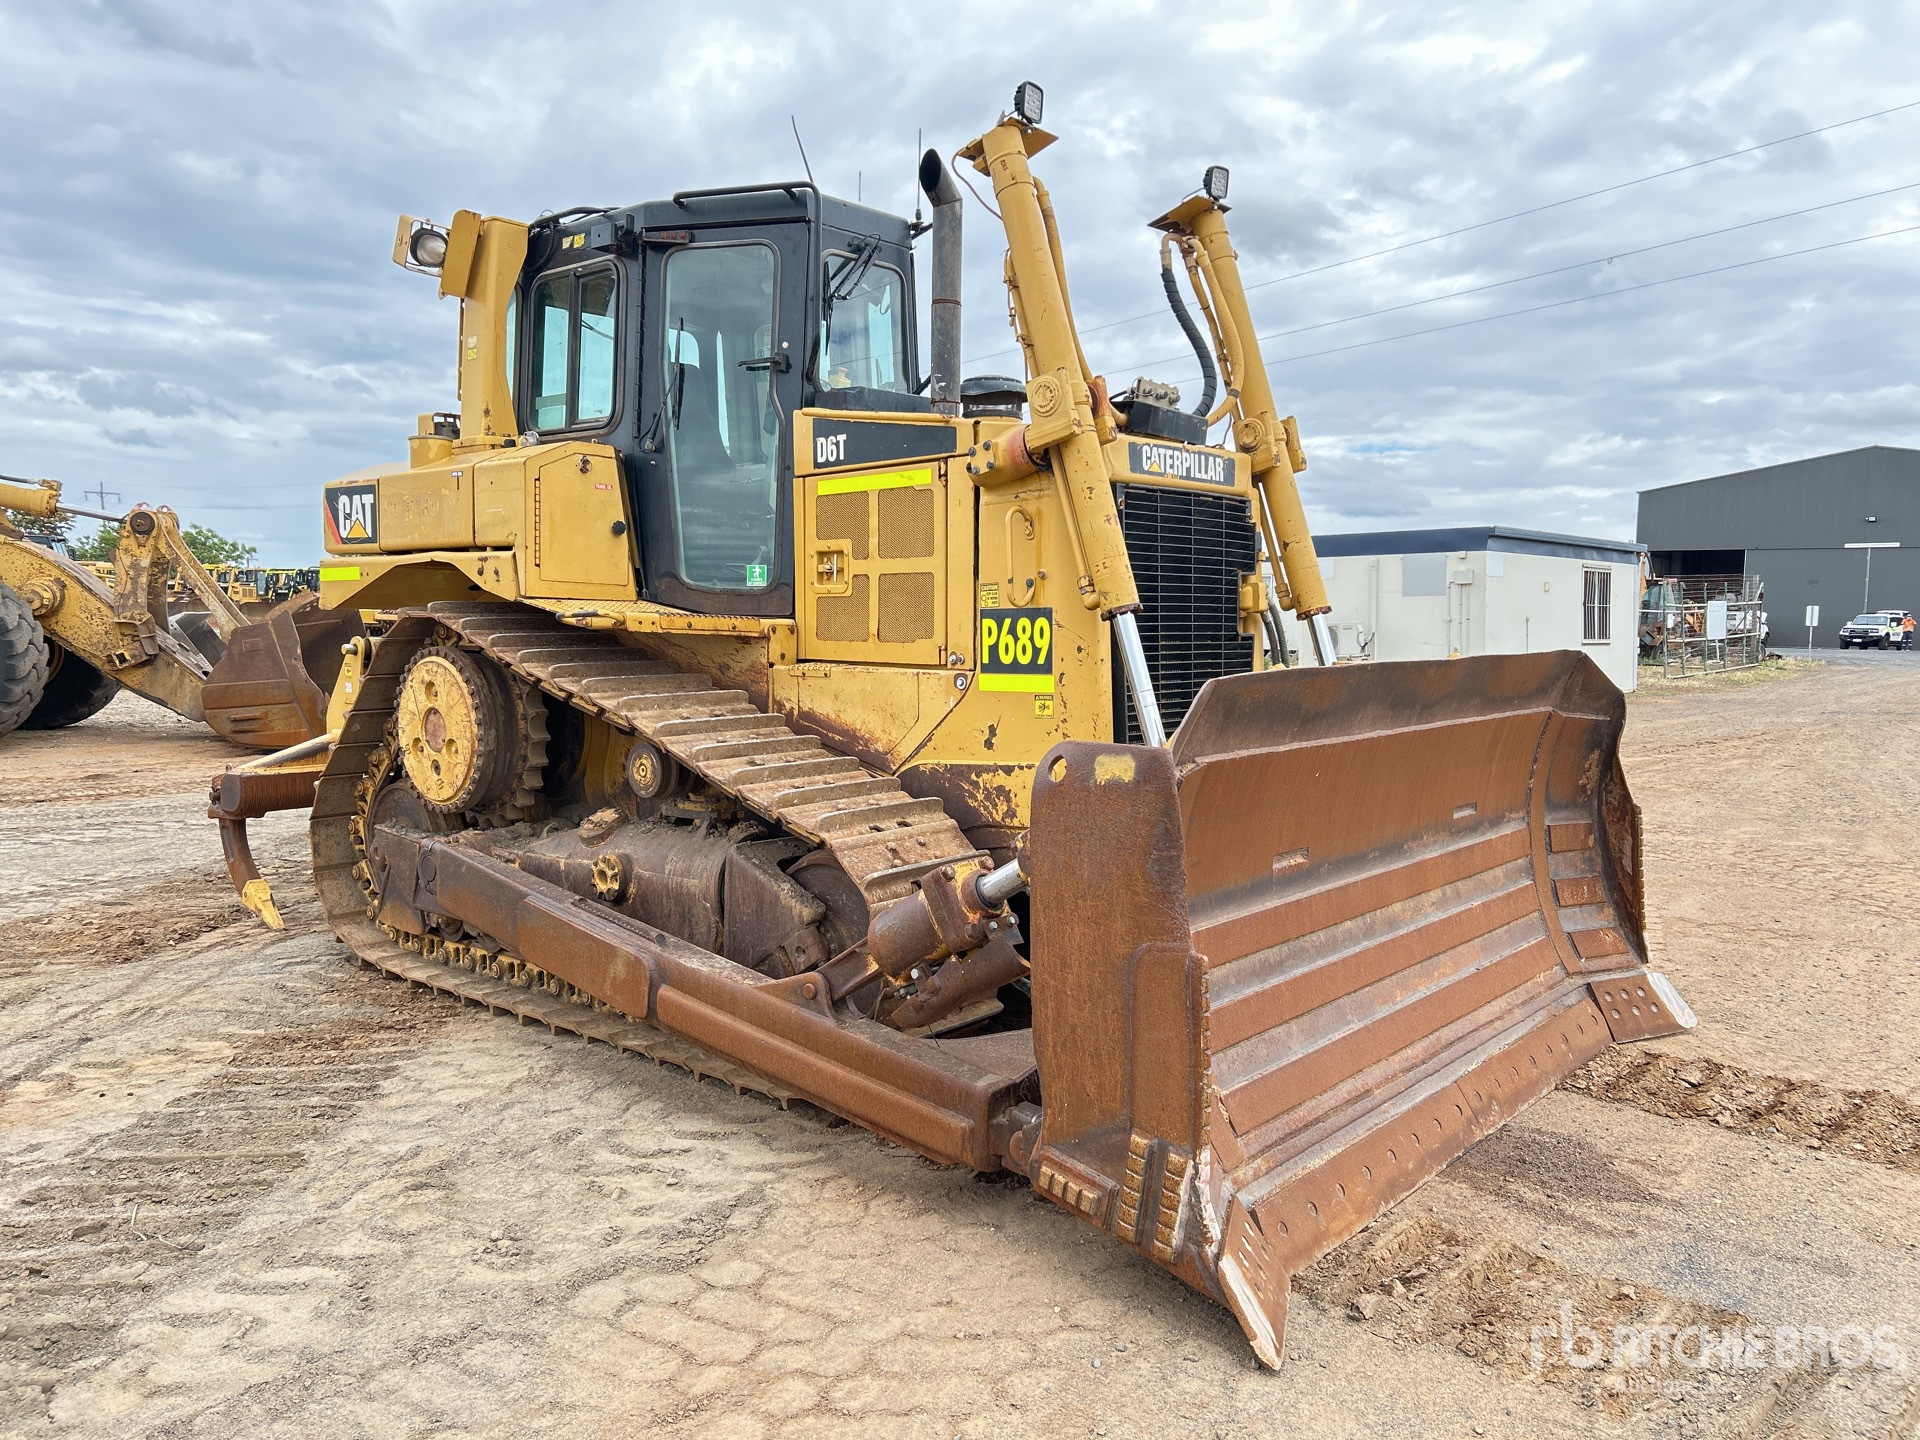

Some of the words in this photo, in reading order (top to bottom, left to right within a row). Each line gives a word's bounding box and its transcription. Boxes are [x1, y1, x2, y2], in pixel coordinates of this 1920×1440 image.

[816, 433, 847, 463] D6T
[1142, 443, 1224, 483] CATERPILLAR
[338, 493, 374, 539] CAT
[982, 617, 1051, 666] P689
